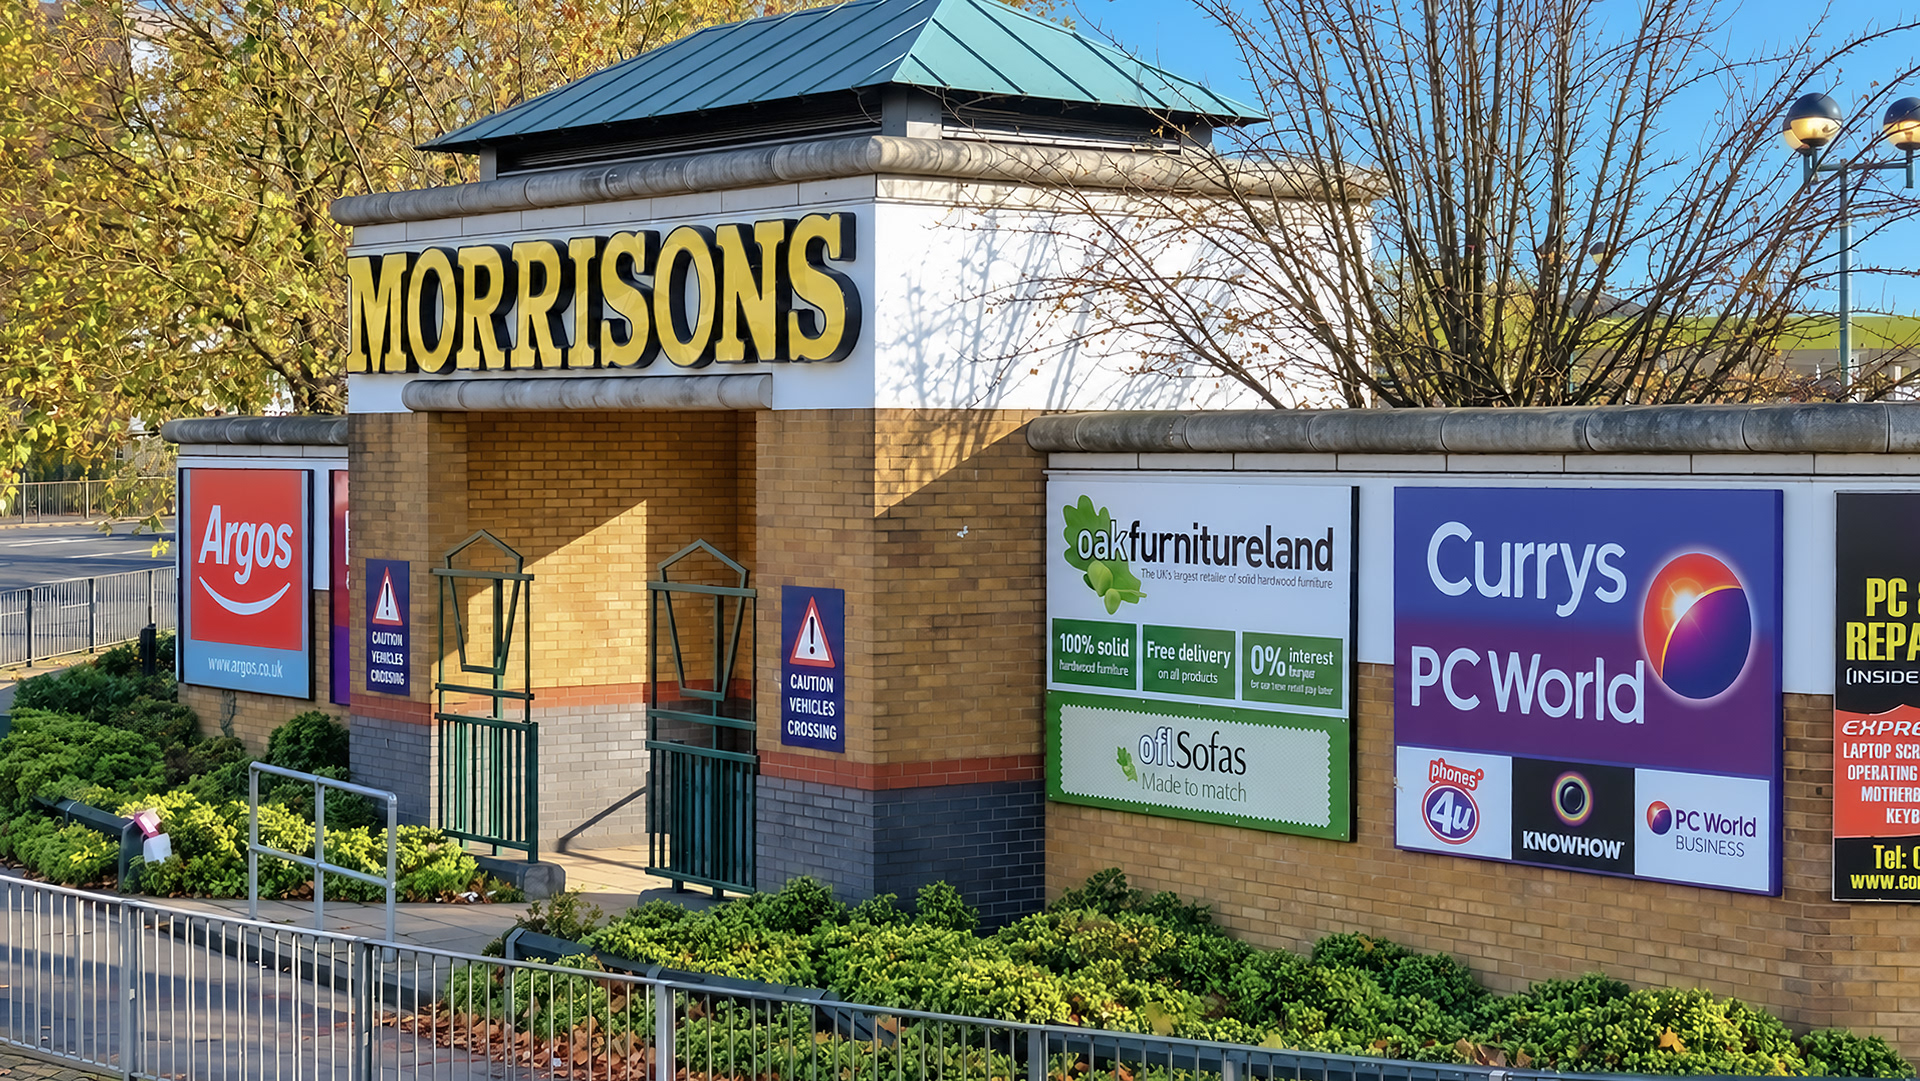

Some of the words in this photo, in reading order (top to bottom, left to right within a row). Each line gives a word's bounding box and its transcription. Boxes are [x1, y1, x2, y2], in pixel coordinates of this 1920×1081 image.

[347, 212, 862, 374] MORRISONS
[198, 505, 293, 584] Argos
[1076, 519, 1334, 572] oakfurnitureland
[1141, 568, 1155, 579] The
[1156, 569, 1172, 580] UK's
[1174, 570, 1198, 583] largest
[1200, 572, 1226, 583] retailer
[1228, 572, 1237, 583] of
[1257, 574, 1296, 587] hardwood
[1298, 576, 1333, 589] furniture
[1427, 521, 1627, 617] Currys
[1866, 577, 1908, 617] PC
[1060, 633, 1094, 655] 100%
[1097, 637, 1129, 657] solid
[1147, 641, 1175, 660] Free
[1179, 643, 1231, 669] delivery
[1846, 622, 1920, 661] REPA
[208, 657, 283, 678] www.argos.co.uk
[1059, 659, 1095, 673] hardwood
[1251, 645, 1286, 676] 0%
[1289, 647, 1334, 665] interest
[790, 674, 834, 693] CAUTION
[1158, 670, 1169, 680] on
[1170, 668, 1179, 681] all
[1182, 671, 1218, 684] products
[1411, 645, 1481, 711] PC
[1487, 650, 1645, 724] World
[1846, 668, 1919, 685] (INSIDE
[789, 697, 835, 717] VEHICLES
[787, 720, 837, 741] CROSSING
[1139, 726, 1247, 775] oflSofas
[1843, 742, 1891, 759] LAPTOP
[1431, 761, 1476, 788] phones
[1848, 765, 1918, 781] OPERATING
[1142, 772, 1181, 795] Made
[1184, 776, 1199, 797] to
[1202, 781, 1247, 803] match
[1430, 791, 1472, 834] 4u
[1675, 809, 1700, 832] PC
[1704, 812, 1757, 838] World
[1522, 831, 1621, 860] KNOWHOW
[1676, 835, 1745, 858] BUSINESS
[1873, 844, 1907, 870] Tel:
